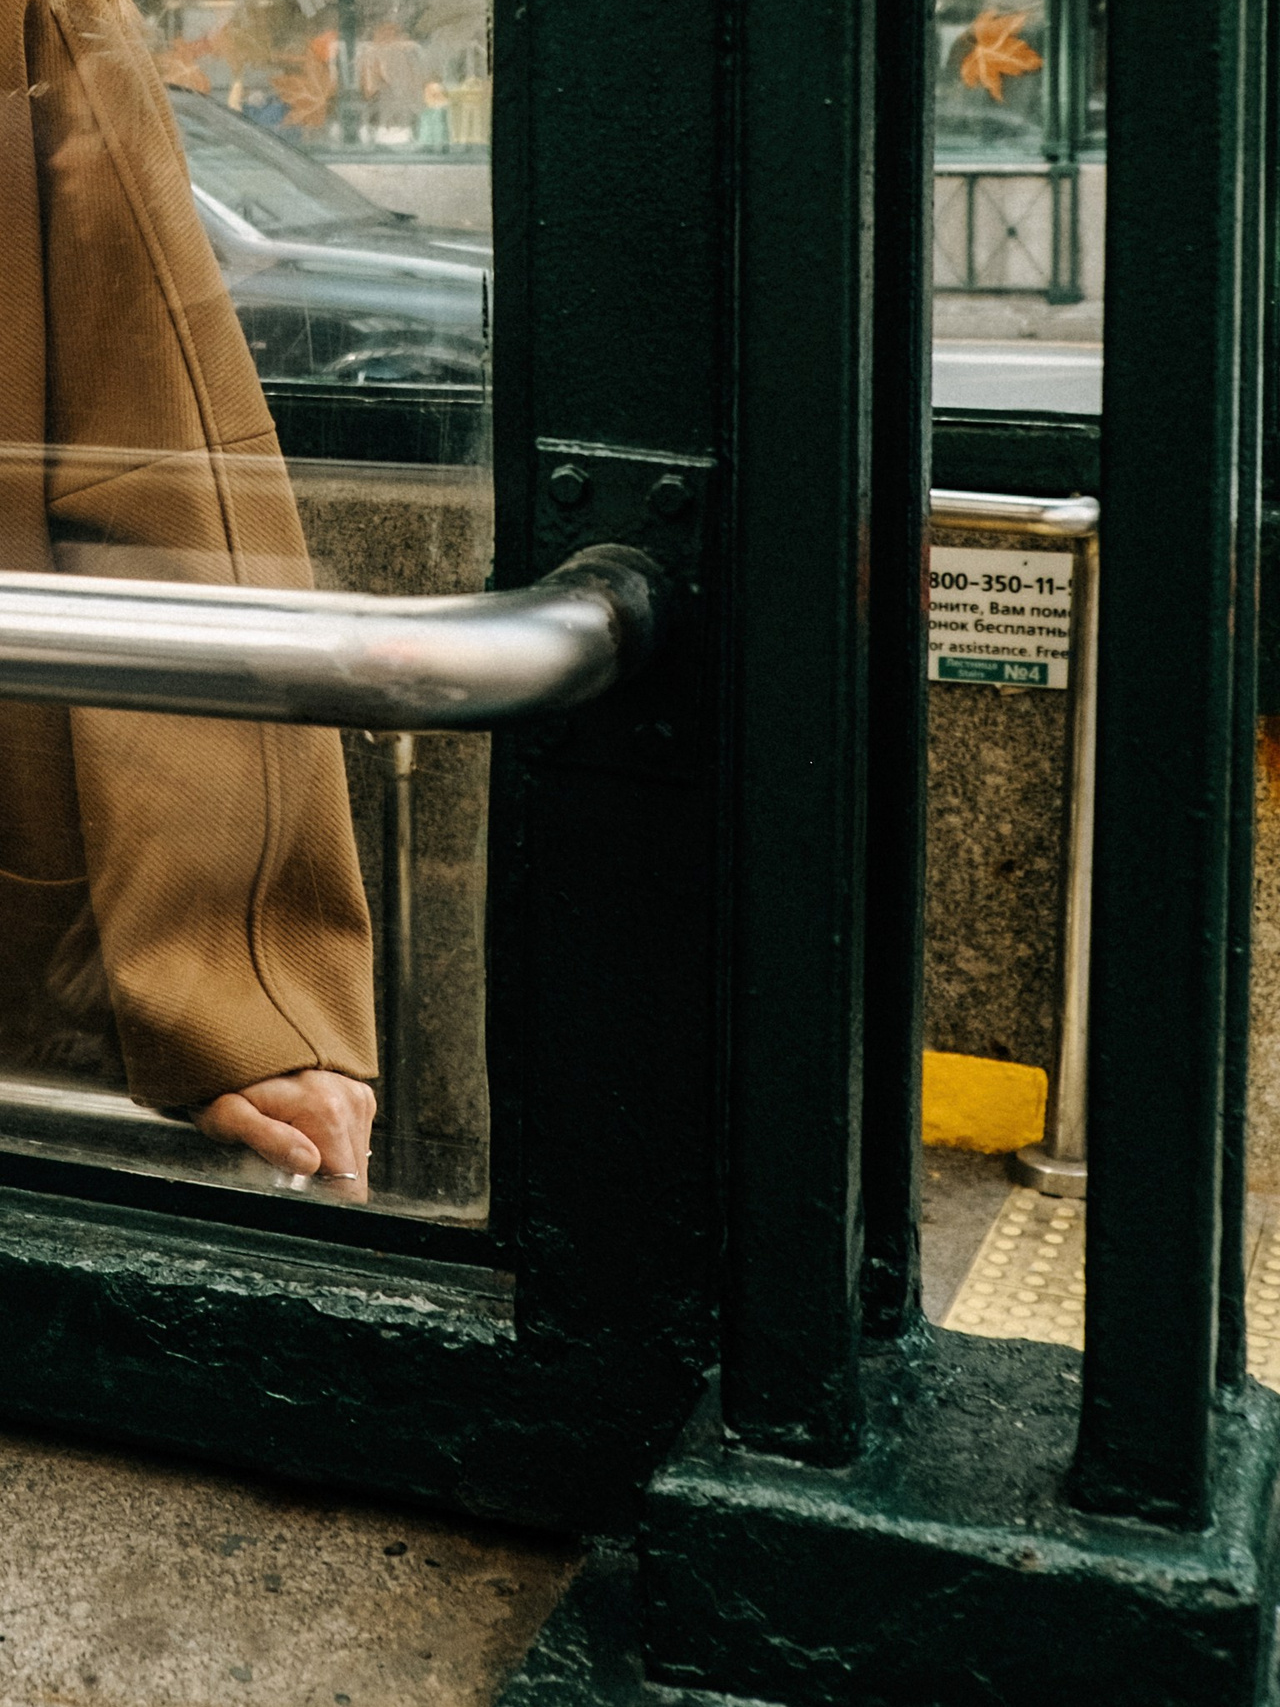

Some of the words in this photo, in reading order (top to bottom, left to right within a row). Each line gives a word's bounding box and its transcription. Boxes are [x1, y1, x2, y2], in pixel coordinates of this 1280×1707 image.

[990, 602, 1025, 617] Вам
[949, 641, 1031, 657] assistance.
[1036, 645, 1069, 659] Free
[1004, 664, 1041, 682] №4
